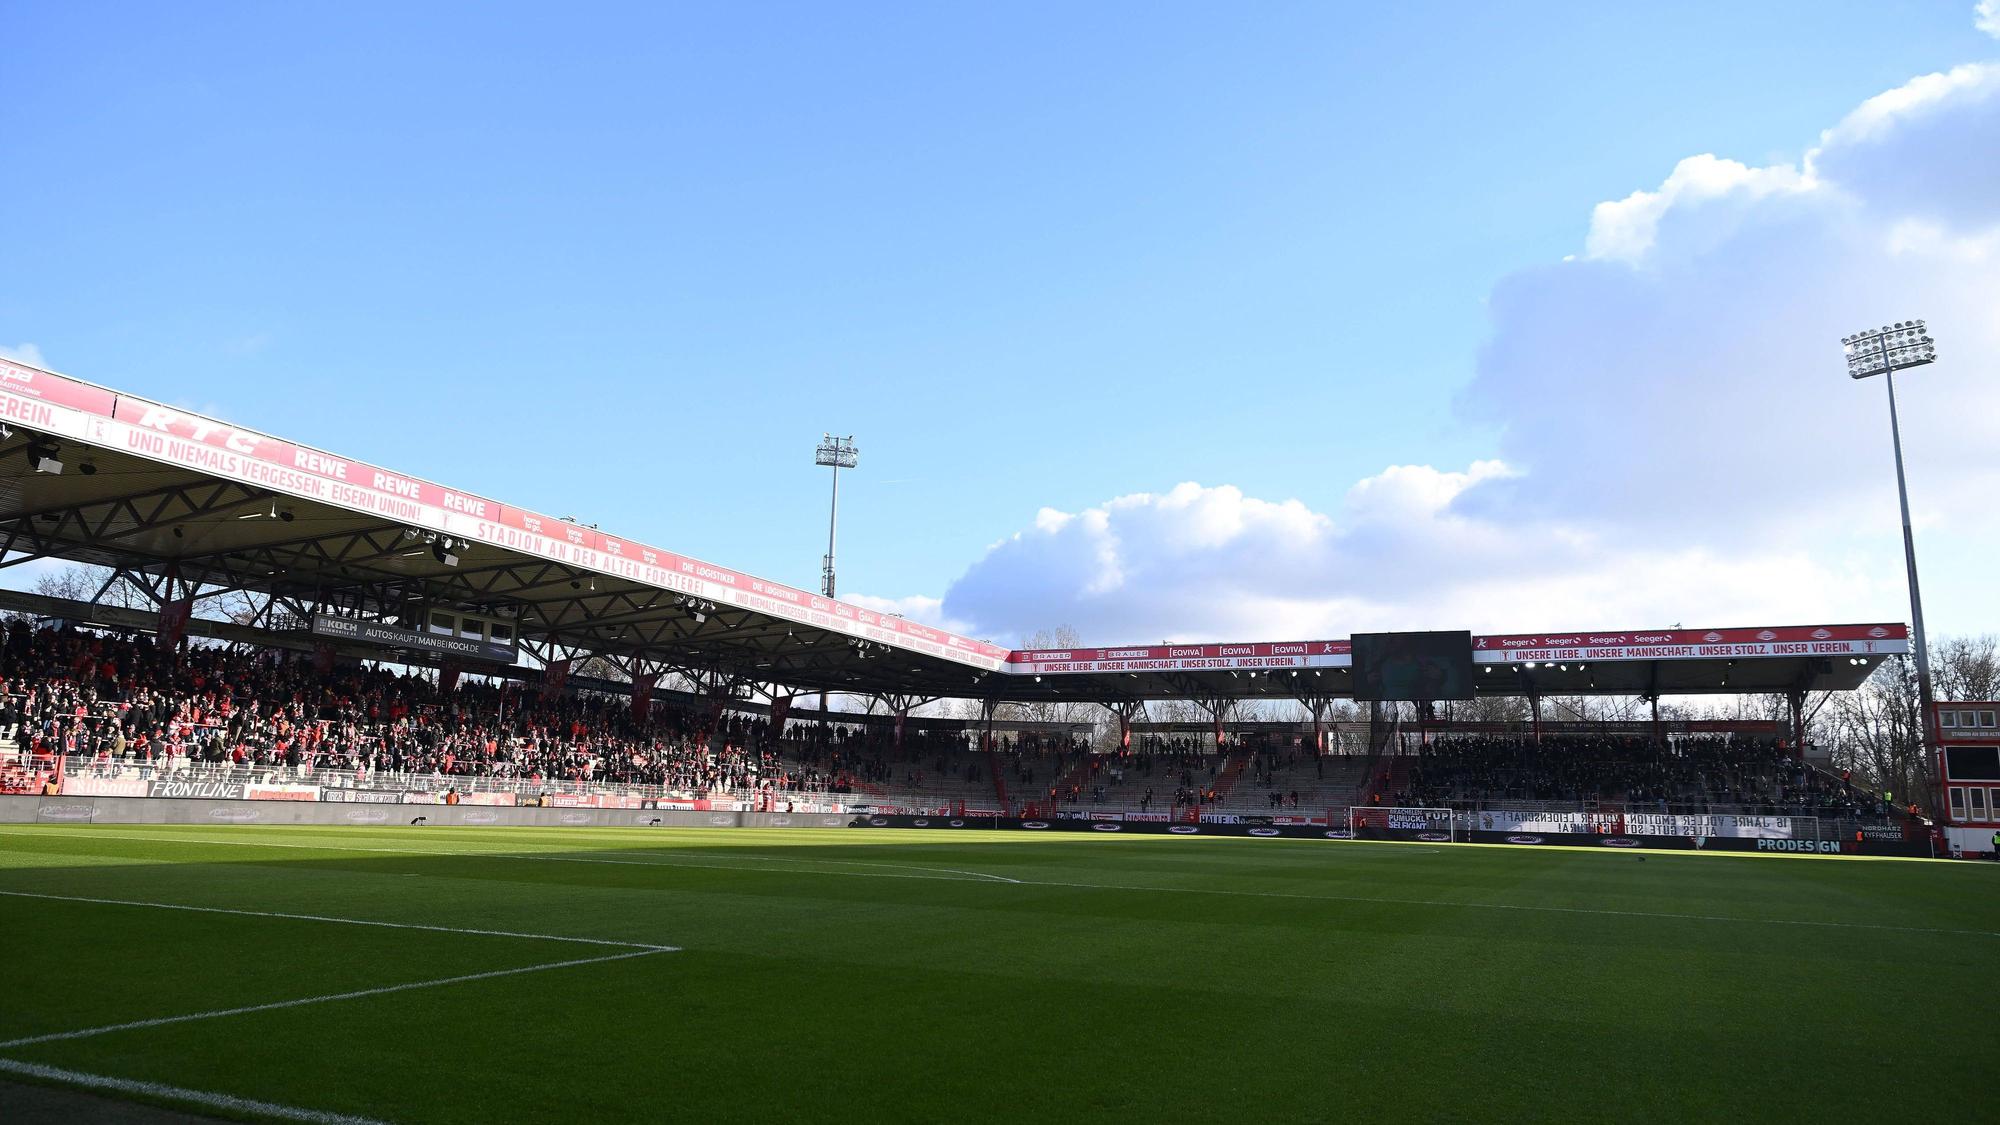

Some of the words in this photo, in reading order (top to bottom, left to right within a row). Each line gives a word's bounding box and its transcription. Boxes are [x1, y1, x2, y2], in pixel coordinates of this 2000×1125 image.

[294, 450, 347, 479] REWE
[128, 430, 164, 455] UND
[167, 440, 236, 473] NIEMALS
[241, 457, 325, 497] VERGESSEN:
[331, 484, 376, 510] EISERN
[379, 496, 421, 521] UNION!
[373, 472, 420, 499] REWE
[443, 491, 485, 517] REWE
[478, 522, 543, 554] STADION
[549, 542, 566, 560] AN
[573, 548, 597, 568] DER
[603, 555, 640, 578] ALTEN
[682, 562, 693, 573] DIE
[696, 566, 735, 584] LOGISTIKER
[752, 581, 763, 593] DIE
[765, 584, 798, 601] LOGISTIKER
[735, 591, 749, 605] UND
[751, 594, 776, 615] NIEMALS
[327, 619, 357, 632] KOCH
[1502, 639, 1529, 647] Seeger
[1545, 637, 1573, 646] Seeger
[1589, 636, 1618, 645] Seeger
[1634, 635, 1664, 644] Seeger
[1108, 650, 1148, 658] BRAUER
[1516, 650, 1551, 660] UNSERE
[1554, 650, 1582, 658] LIEBE.
[1586, 648, 1623, 658] UNSERE
[1626, 647, 1695, 657] MANNSCHAFT.
[1699, 646, 1732, 656] UNSER
[1735, 645, 1768, 655] STOLZ.
[1773, 644, 1808, 654] UNSER
[1811, 643, 1853, 653] VEREIN.
[1044, 662, 1071, 672] UNSERE
[1073, 662, 1094, 671] LIEBE.
[1097, 661, 1124, 670] UNSERE
[1127, 660, 1178, 669] MANNSCHAFT.
[1182, 658, 1206, 668] UNSER
[1208, 657, 1232, 667] STOLZ.
[1237, 657, 1262, 666] UNSER
[1265, 656, 1296, 666] VEREIN.
[150, 781, 243, 798] FRONTLINE
[1388, 815, 1425, 823] PUMUCKL
[1388, 821, 1427, 829] SELFKANT
